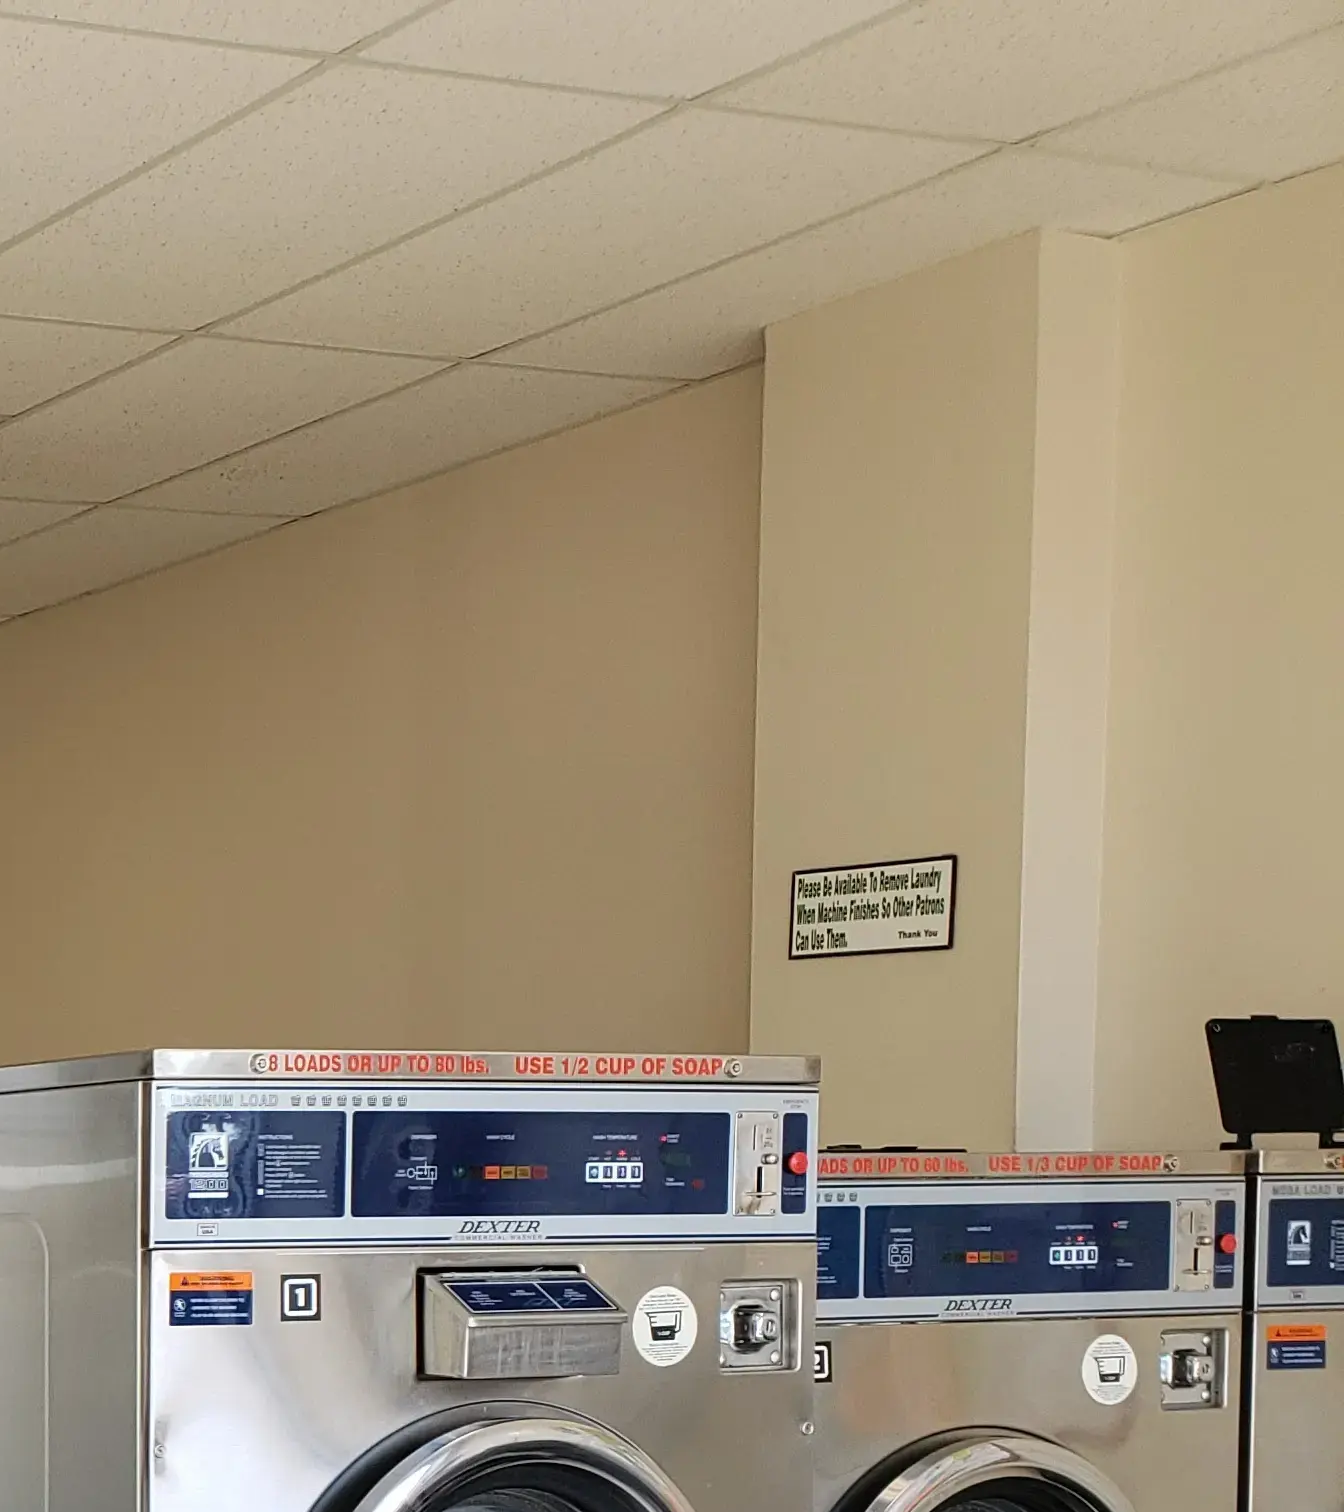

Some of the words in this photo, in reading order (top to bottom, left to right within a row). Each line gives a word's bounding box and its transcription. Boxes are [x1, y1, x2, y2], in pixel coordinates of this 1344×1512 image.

[797, 879, 821, 899] Please
[823, 876, 832, 897] Be
[834, 873, 867, 896] Available
[869, 872, 878, 893] To
[879, 870, 909, 892] Remove
[911, 867, 942, 893] Laundry
[797, 904, 815, 925] When
[817, 900, 848, 923] Machine
[849, 898, 880, 921] Finishes
[881, 897, 891, 919] So
[893, 896, 914, 918] Other
[915, 894, 944, 916] Patrons
[795, 931, 809, 951] Can
[811, 929, 825, 950] Use
[826, 928, 848, 949] Them.
[897, 930, 921, 940] Thank
[924, 929, 938, 938] You
[268, 1054, 278, 1072] 8
[284, 1054, 342, 1073] LOADS
[347, 1054, 371, 1073] OR
[378, 1055, 401, 1073] UP
[407, 1055, 430, 1073] TO
[435, 1055, 455, 1073] 80
[461, 1055, 490, 1074] lbs.
[515, 1056, 554, 1075] USE
[561, 1057, 589, 1077] 1/2
[595, 1057, 636, 1076] CUP
[641, 1057, 666, 1076] OF
[671, 1057, 724, 1076] SOAP
[171, 1094, 234, 1107] MAGNUM
[240, 1094, 280, 1107] LOAD
[852, 1157, 873, 1174] OR
[878, 1157, 897, 1174] UP
[901, 1157, 919, 1173] TO
[944, 1156, 969, 1173] lbs.
[988, 1155, 1021, 1172] USE
[1028, 1156, 1050, 1173] 1/3
[1055, 1156, 1089, 1172] CUP
[1093, 1156, 1115, 1172] OF
[1119, 1155, 1163, 1172] SOAP
[457, 1220, 541, 1234] DEXTER
[294, 1287, 306, 1307] 1
[944, 1299, 1013, 1311] DEXTER
